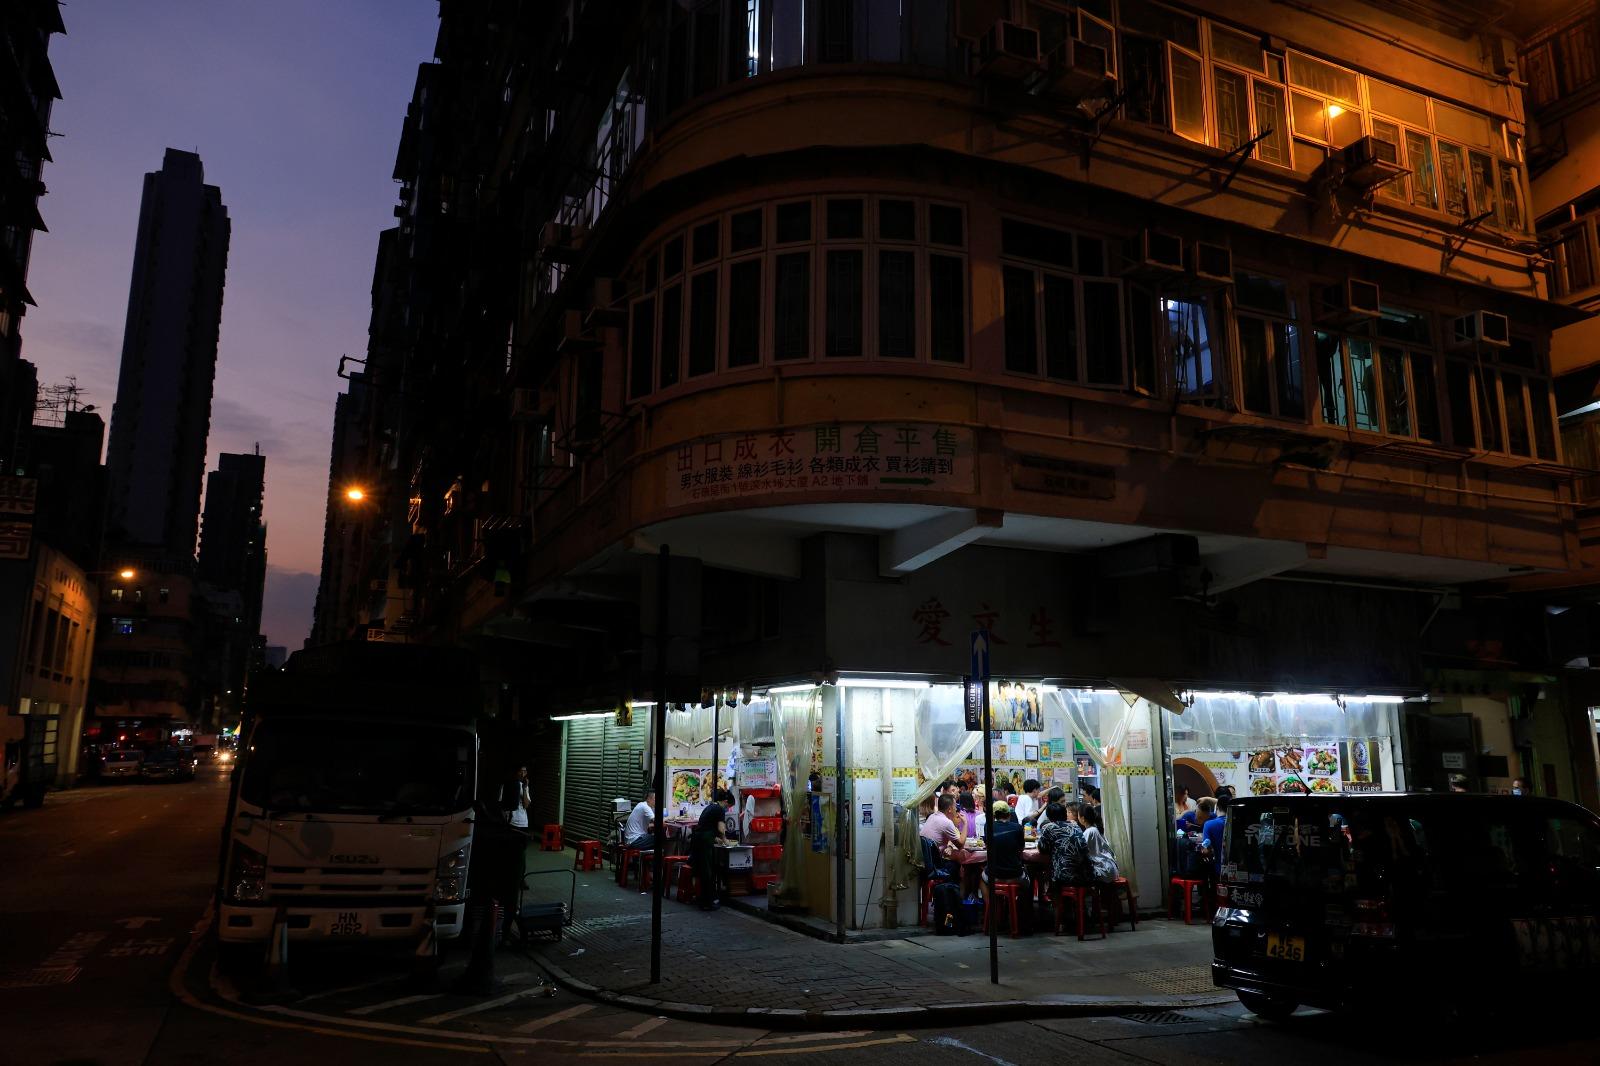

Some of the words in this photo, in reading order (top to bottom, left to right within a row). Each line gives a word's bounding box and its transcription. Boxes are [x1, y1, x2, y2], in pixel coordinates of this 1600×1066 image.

[677, 431, 796, 471] 出口成衣
[815, 424, 958, 457] 開倉平售
[680, 464, 733, 490] 男女服裝
[809, 455, 881, 474] 各類成衣
[328, 854, 381, 864] ISUZU
[338, 912, 358, 923] HN
[330, 923, 362, 935] 2162
